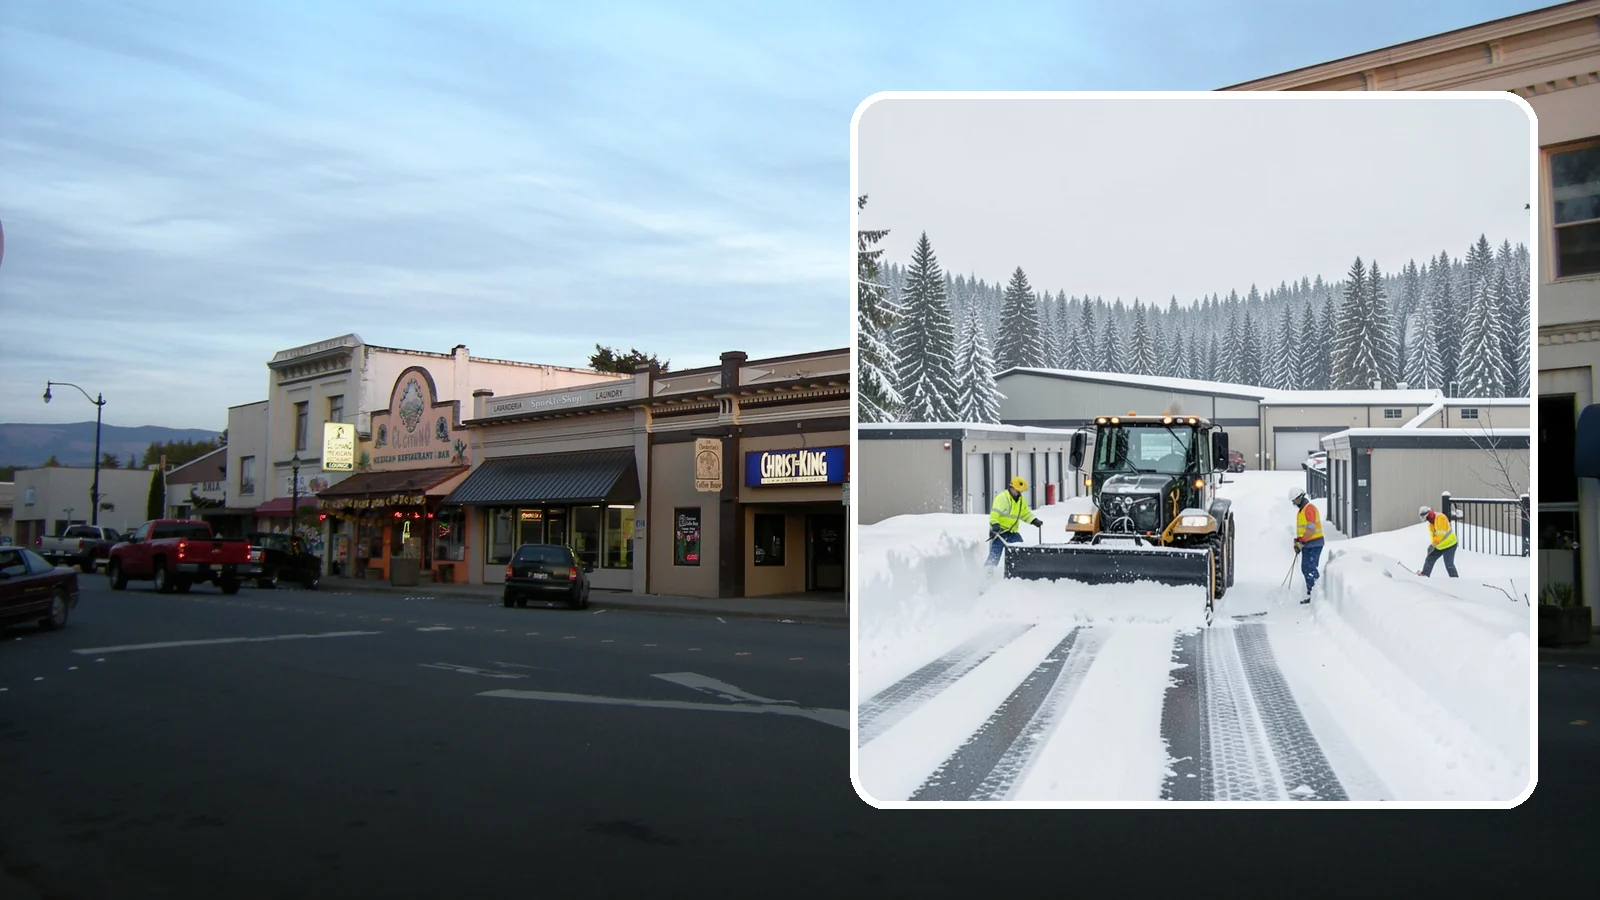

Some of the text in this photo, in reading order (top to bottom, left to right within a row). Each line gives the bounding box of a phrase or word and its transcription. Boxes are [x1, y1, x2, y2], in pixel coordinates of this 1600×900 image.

[595, 389, 623, 400] LAUNDRY
[493, 402, 522, 413] LAVANDERIA
[530, 395, 582, 408] Sparkle Shop
[374, 450, 450, 464] MEXICAN RESTAURANT BAR
[761, 450, 827, 478] CHRIST KING
